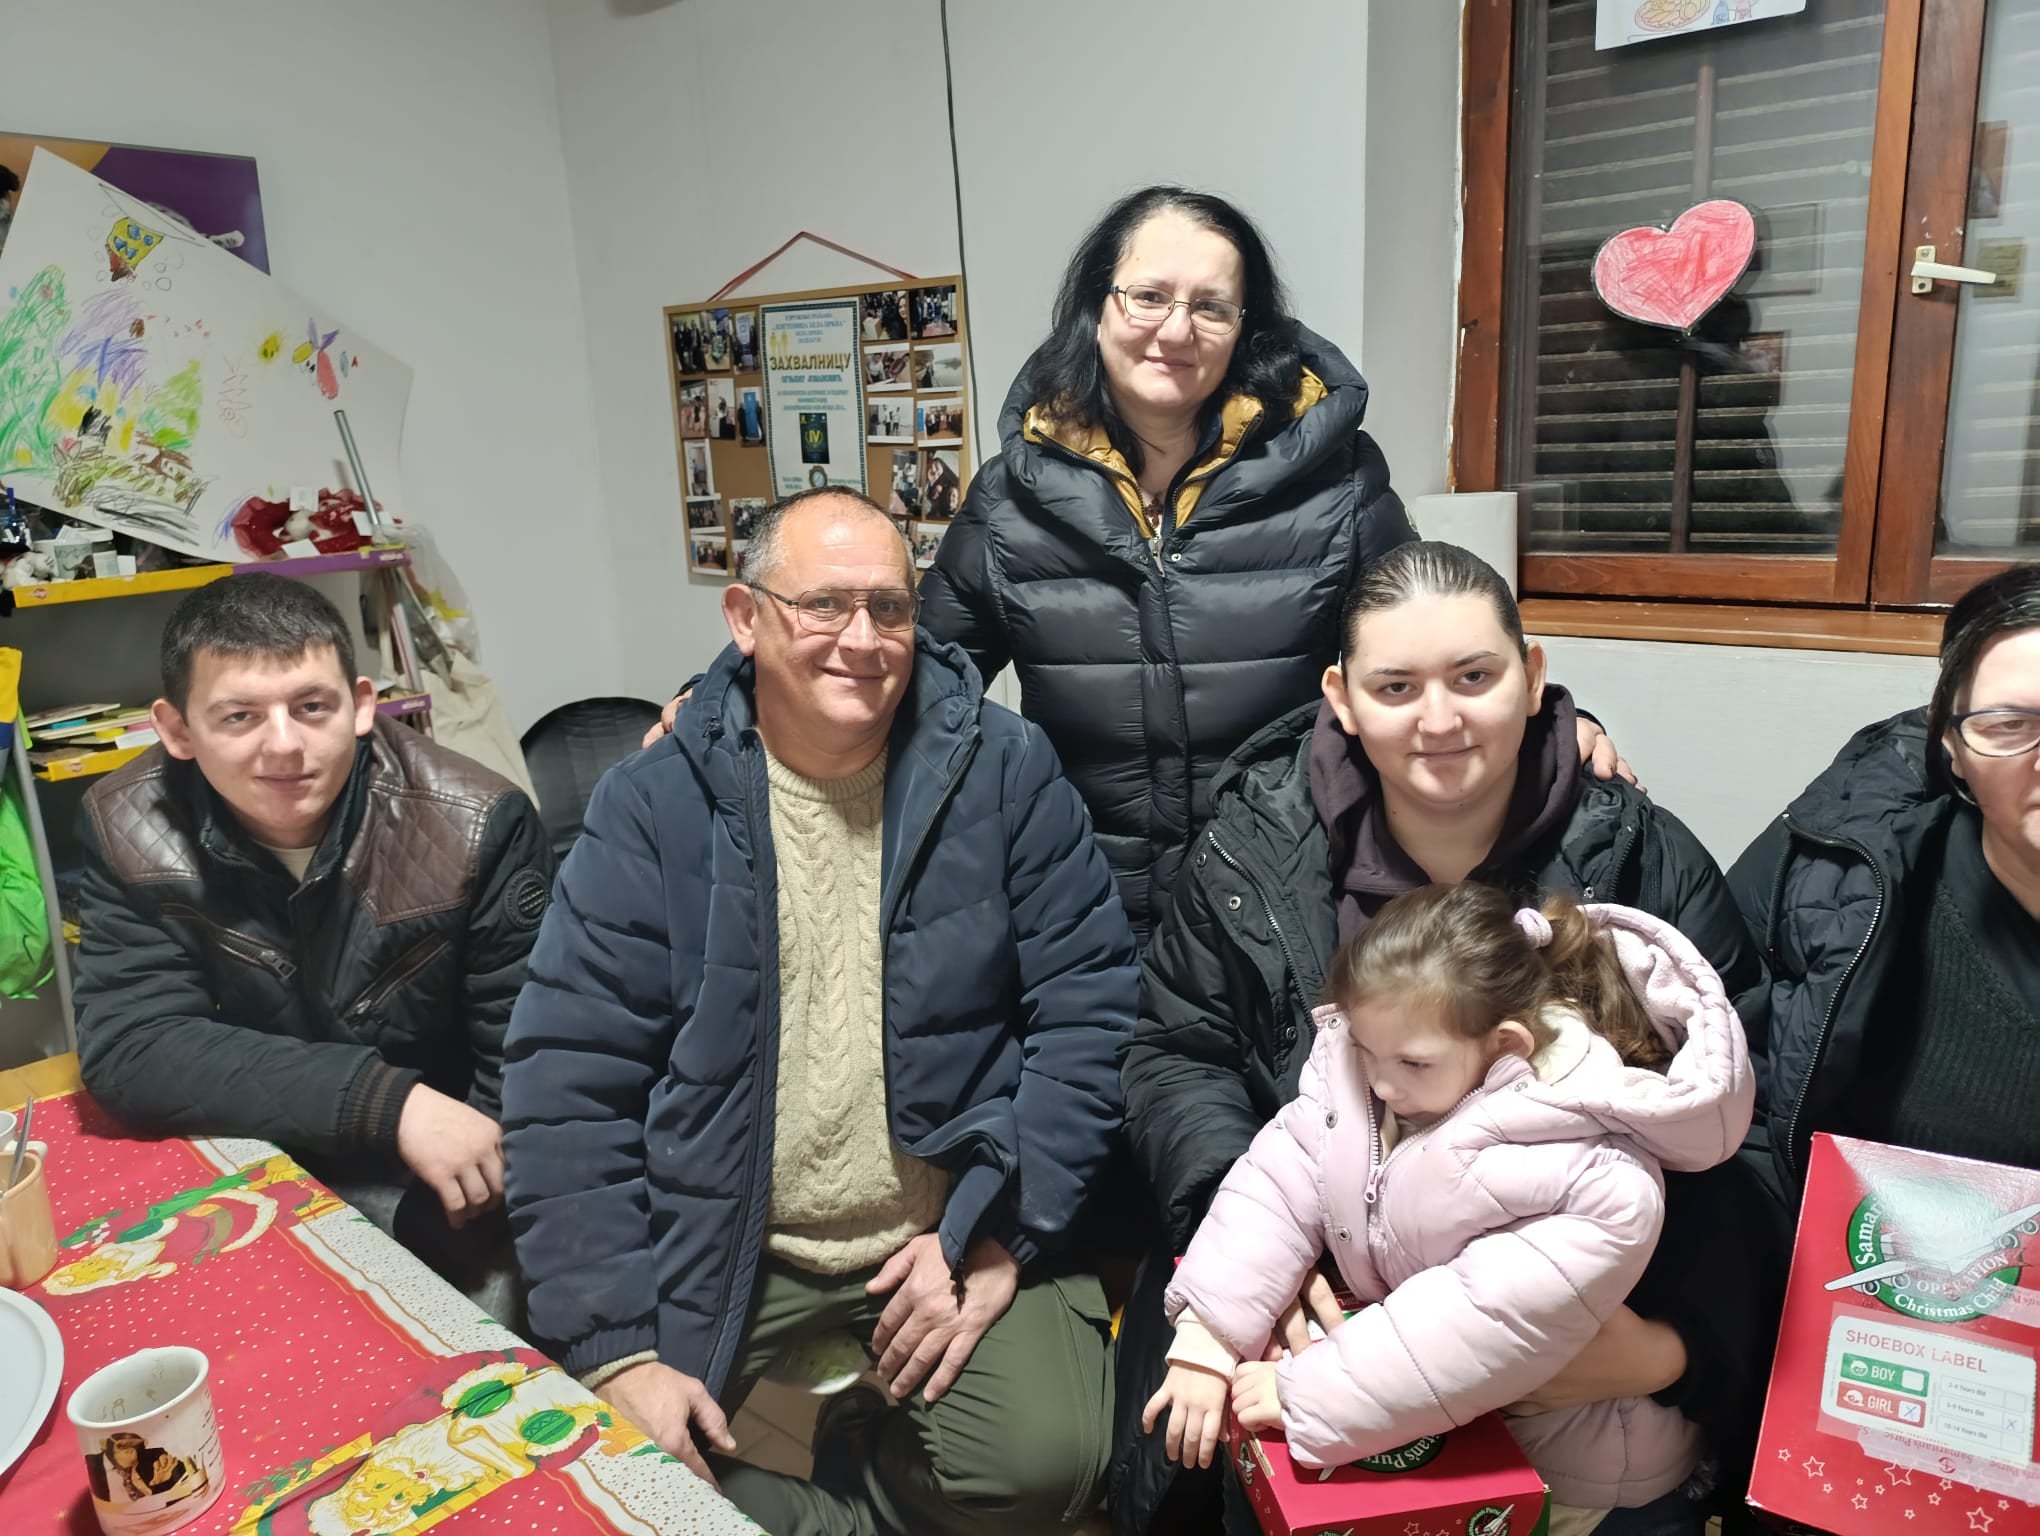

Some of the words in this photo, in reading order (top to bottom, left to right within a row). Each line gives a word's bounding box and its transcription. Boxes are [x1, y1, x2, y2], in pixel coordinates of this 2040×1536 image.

[769, 352, 851, 372] ЗАХВАЛНИЦУ
[1916, 1253, 2009, 1297] OPERATION
[1894, 1293, 1974, 1318] Christmas
[1973, 1277, 2008, 1309] Child
[1846, 1329, 1926, 1359] SHOEBOX
[1931, 1346, 1988, 1374] LABEL
[1871, 1365, 1896, 1382] BOY
[1867, 1395, 1895, 1414] GIRL
